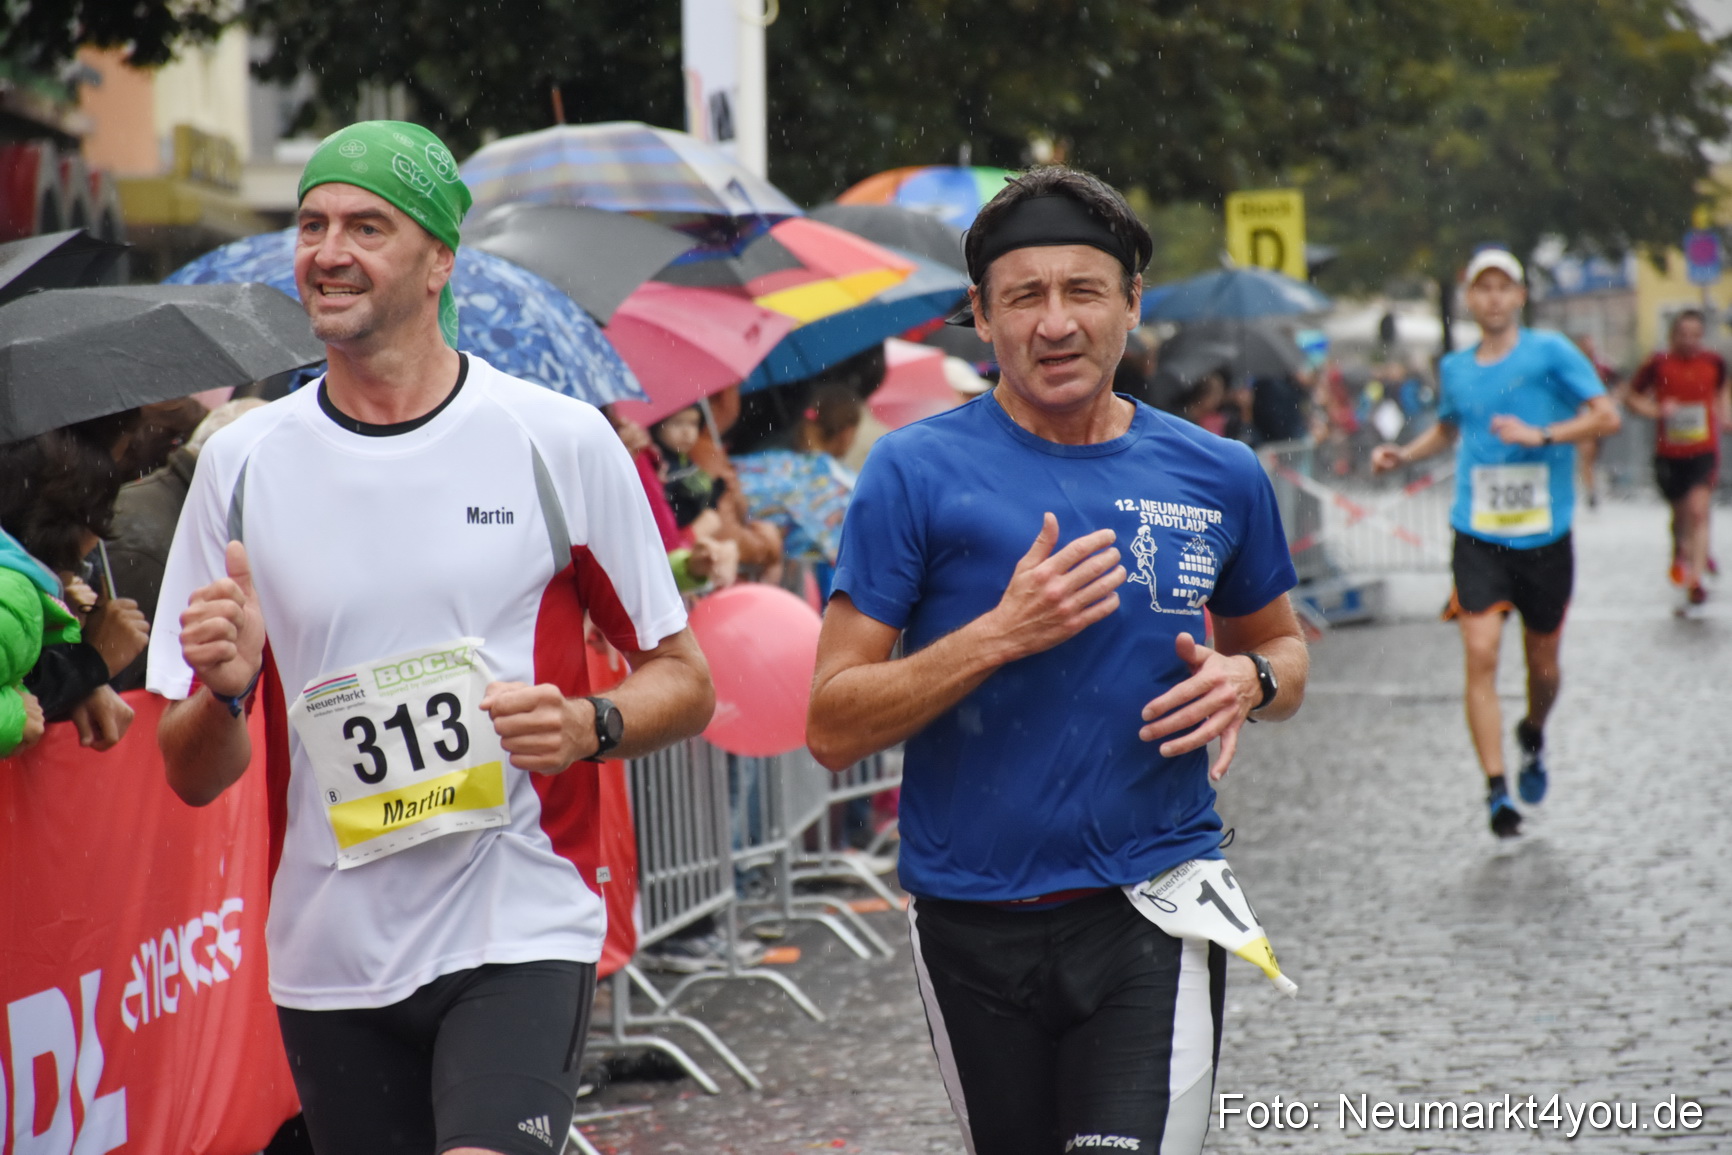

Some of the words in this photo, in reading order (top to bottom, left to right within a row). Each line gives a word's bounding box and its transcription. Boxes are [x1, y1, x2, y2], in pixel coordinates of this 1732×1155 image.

[1250, 226, 1285, 271] D
[467, 506, 514, 525] Martin
[1115, 499, 1139, 511] 12.
[1140, 499, 1222, 524] NEUMARKTER
[1140, 512, 1208, 533] STADTLAUF
[373, 646, 472, 689] BOCK
[306, 689, 366, 712] NeuerMarkt
[343, 692, 469, 785] 313
[328, 790, 338, 803] B
[383, 785, 455, 826] Martin
[0, 968, 127, 1155] DL
[517, 1121, 554, 1148] adidas
